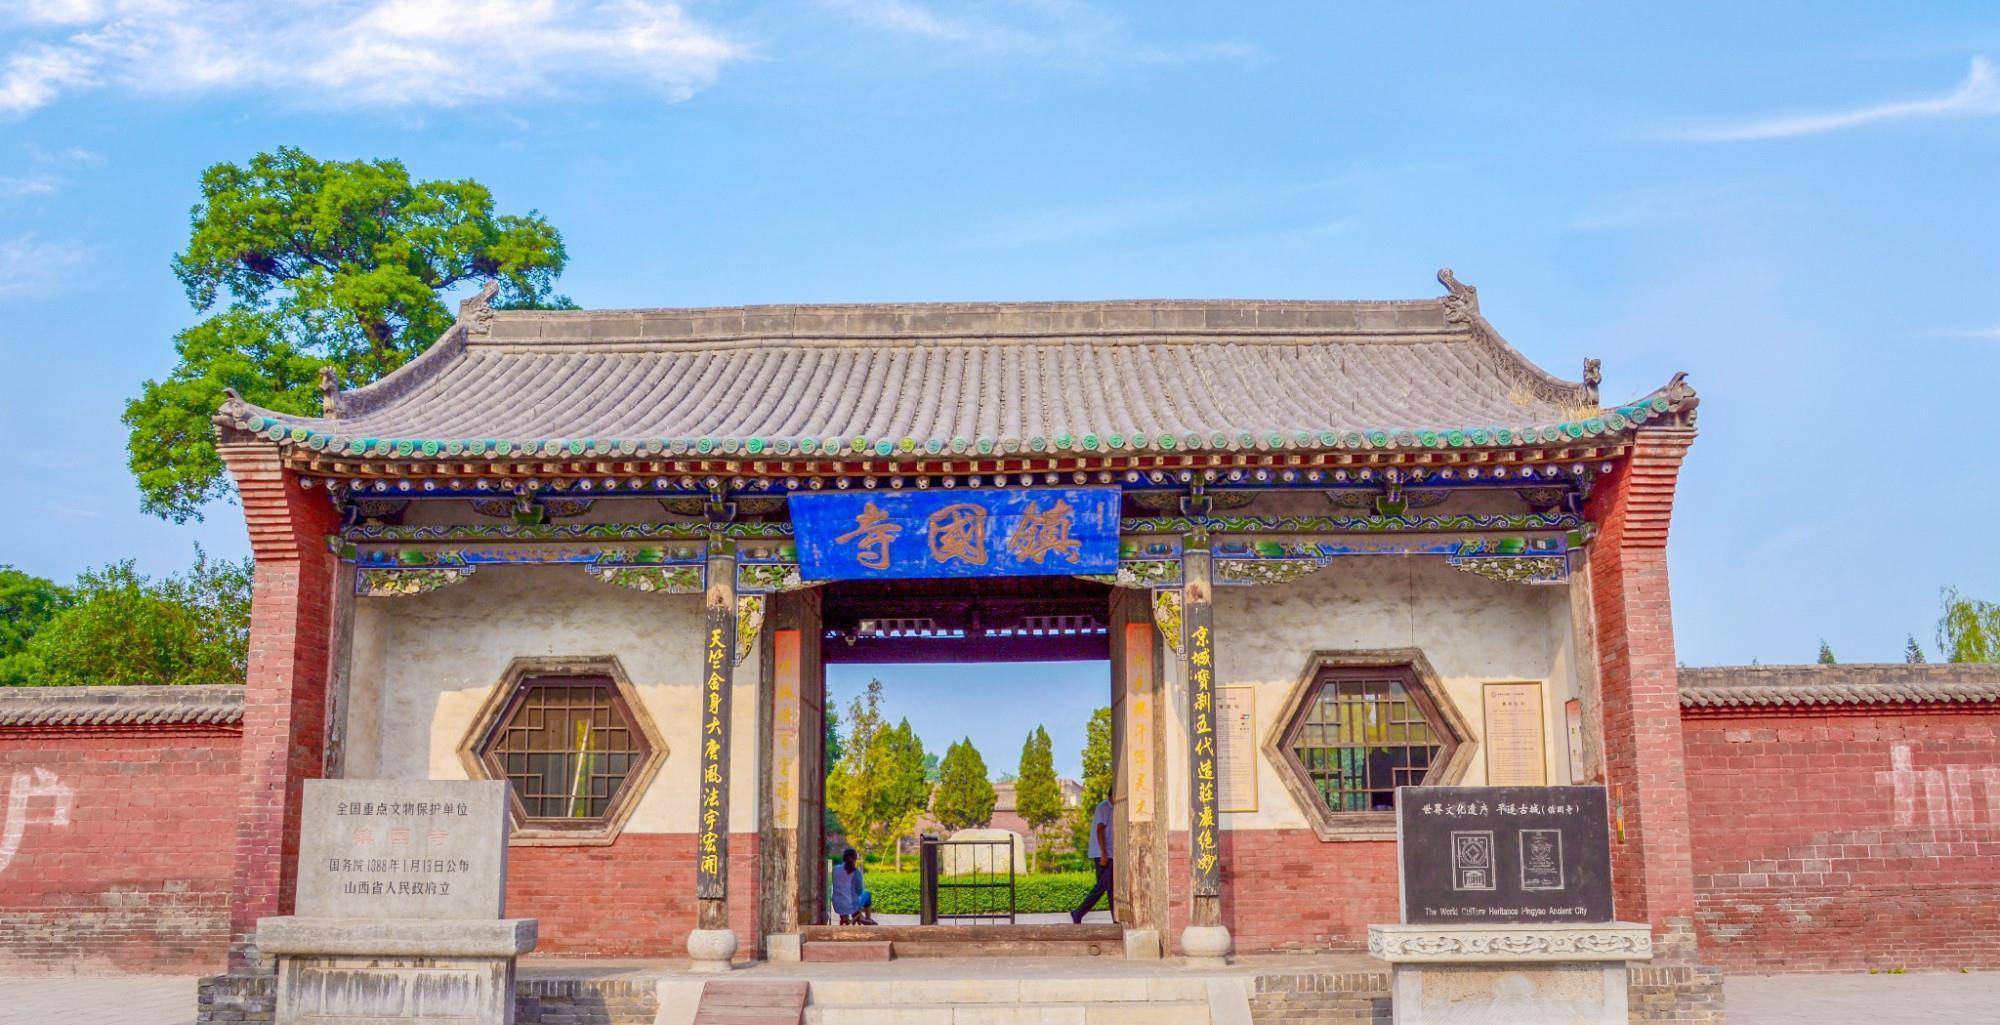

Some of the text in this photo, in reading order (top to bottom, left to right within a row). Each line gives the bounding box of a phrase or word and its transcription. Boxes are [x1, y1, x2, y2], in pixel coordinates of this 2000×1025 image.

[336, 802, 469, 816] 全国重点文物保护单位
[1421, 803, 1489, 816] 世界文化遗产
[344, 881, 450, 896] 山西省人民政府立
[1425, 906, 1437, 916] The
[1439, 906, 1458, 916] World
[1549, 906, 1572, 916] Ancient
[1574, 905, 1588, 917] City
